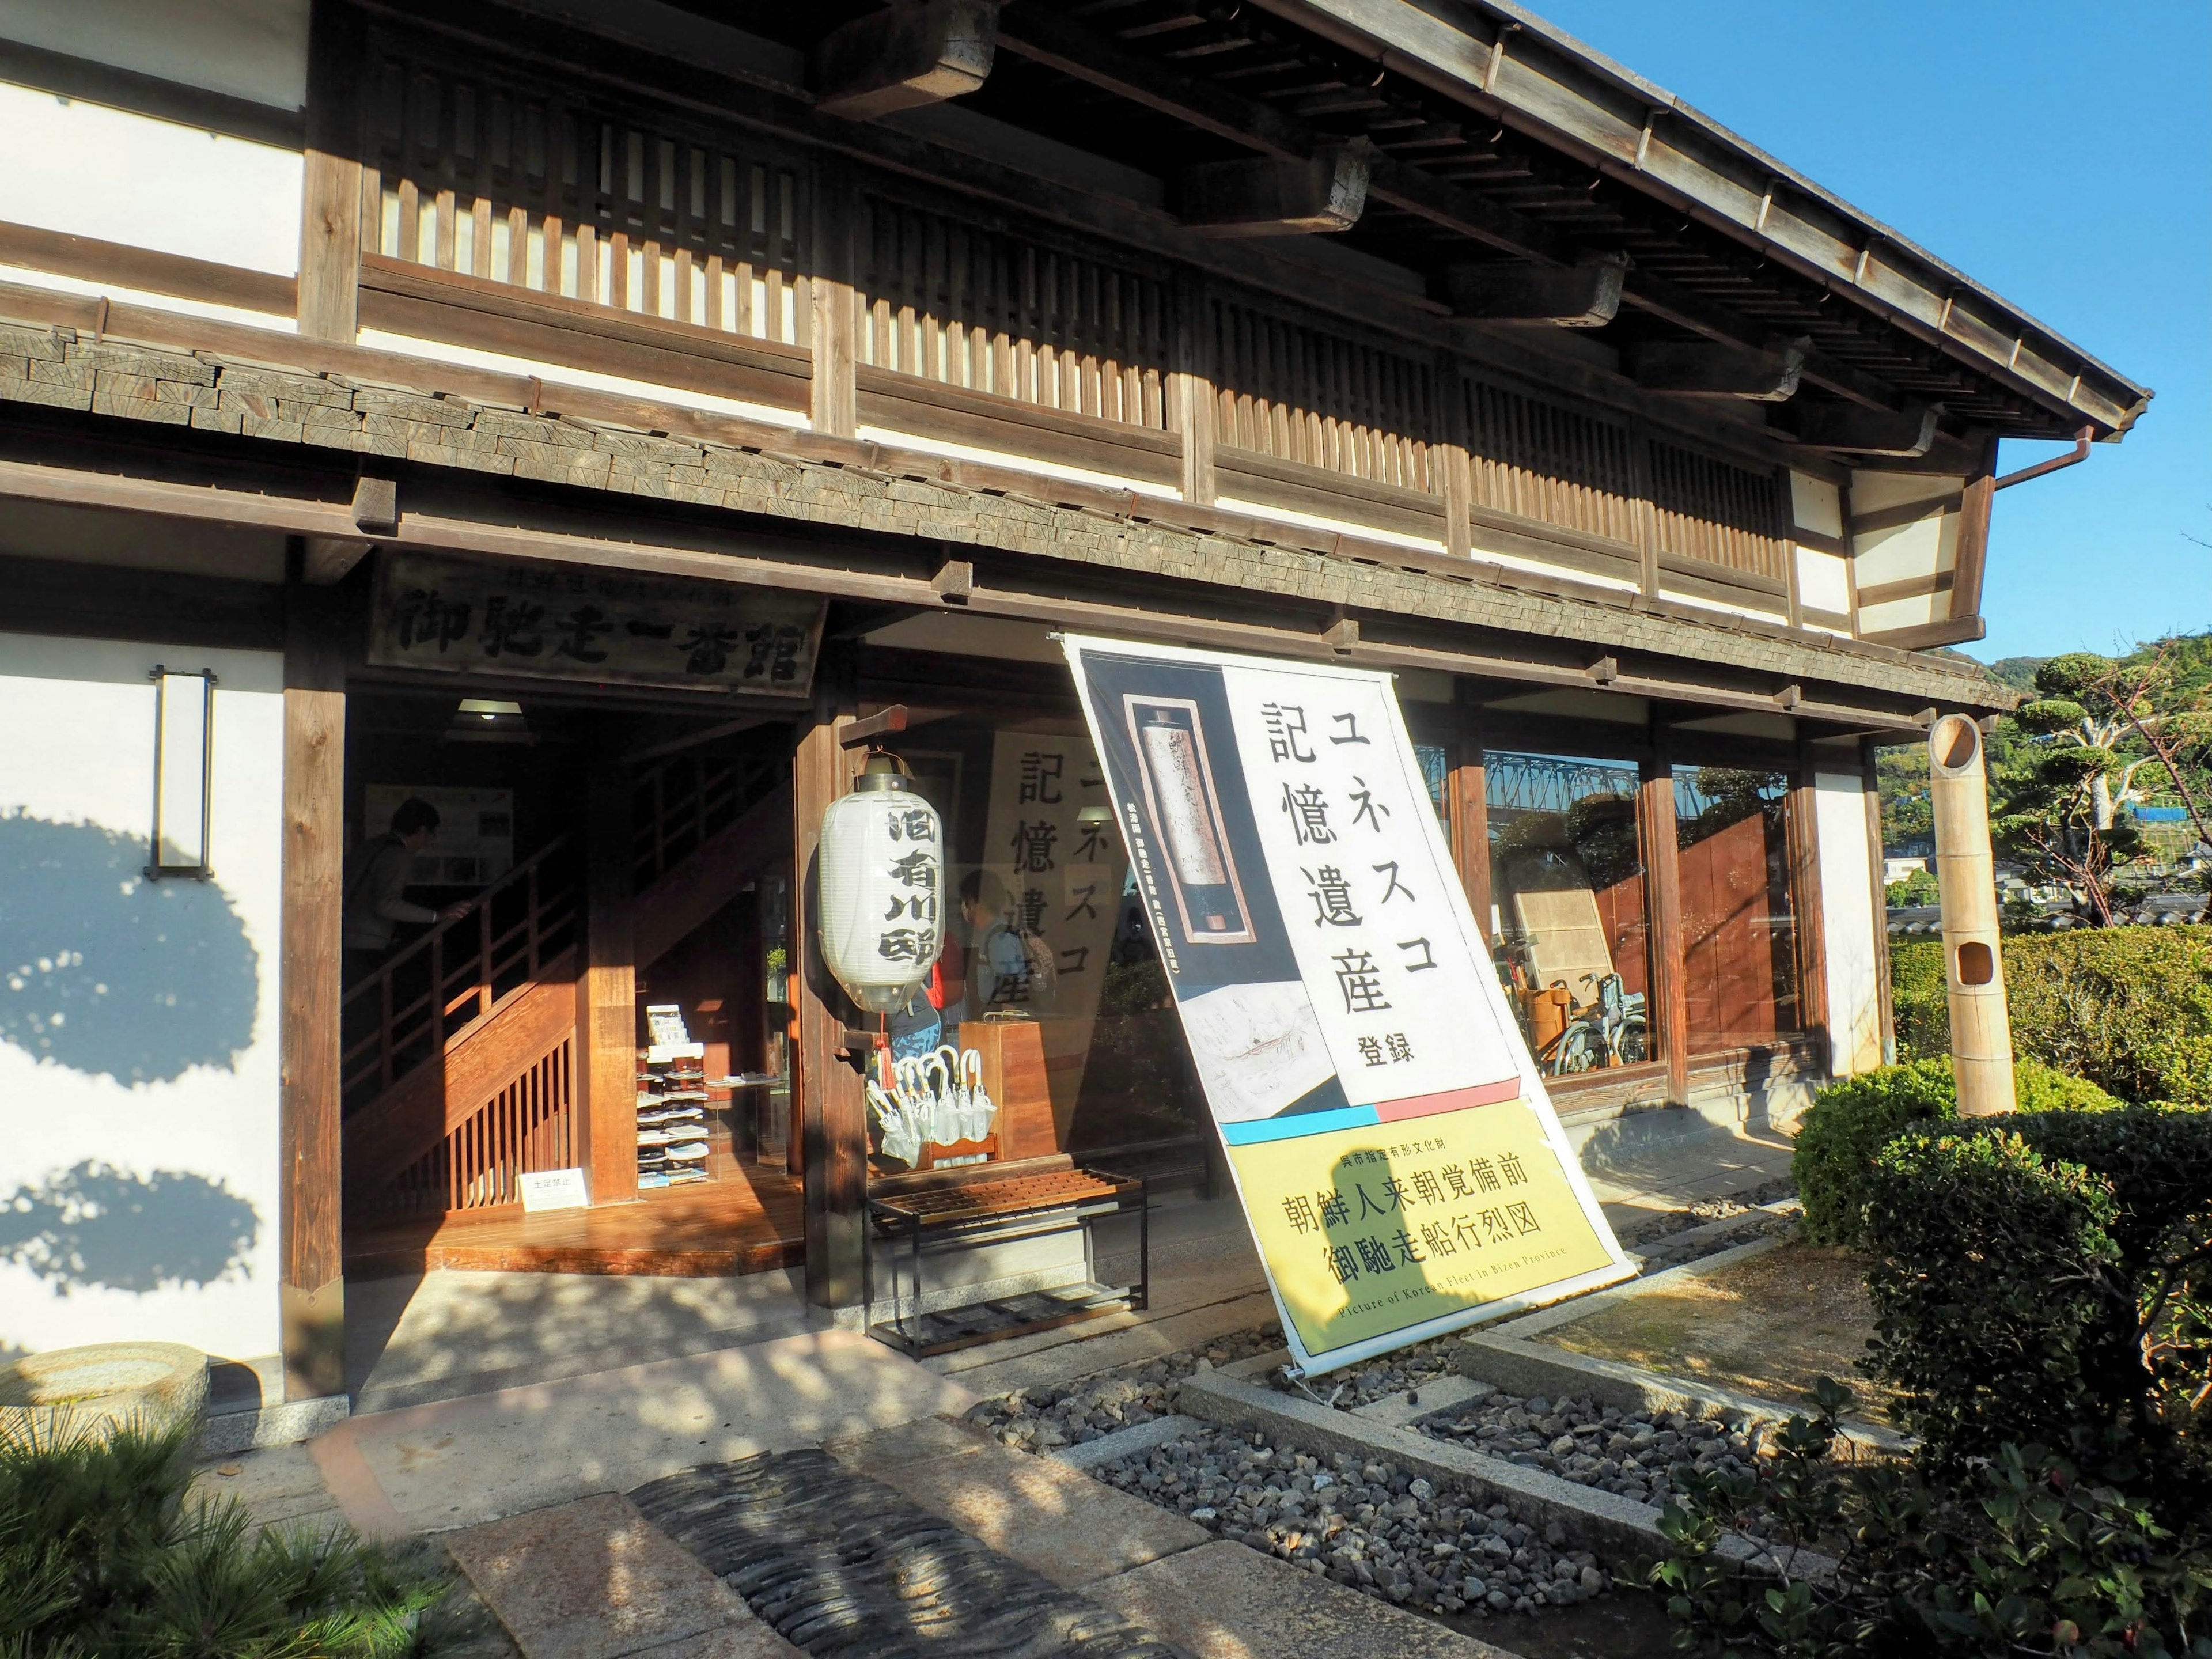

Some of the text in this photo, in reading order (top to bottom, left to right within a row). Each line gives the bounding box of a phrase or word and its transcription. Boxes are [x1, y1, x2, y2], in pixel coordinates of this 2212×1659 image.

[1261, 702, 1393, 1015] 記憶遺産
[1328, 712, 1438, 974] ユネスコ
[1357, 1033, 1415, 1067] 登録
[1282, 1151, 1529, 1236] 朝鮮人来朝覚備前
[1323, 1200, 1542, 1286] 御馳走船行烈図
[1338, 1247, 1567, 1319] Picture of Korean Fleet in Bizen Province
